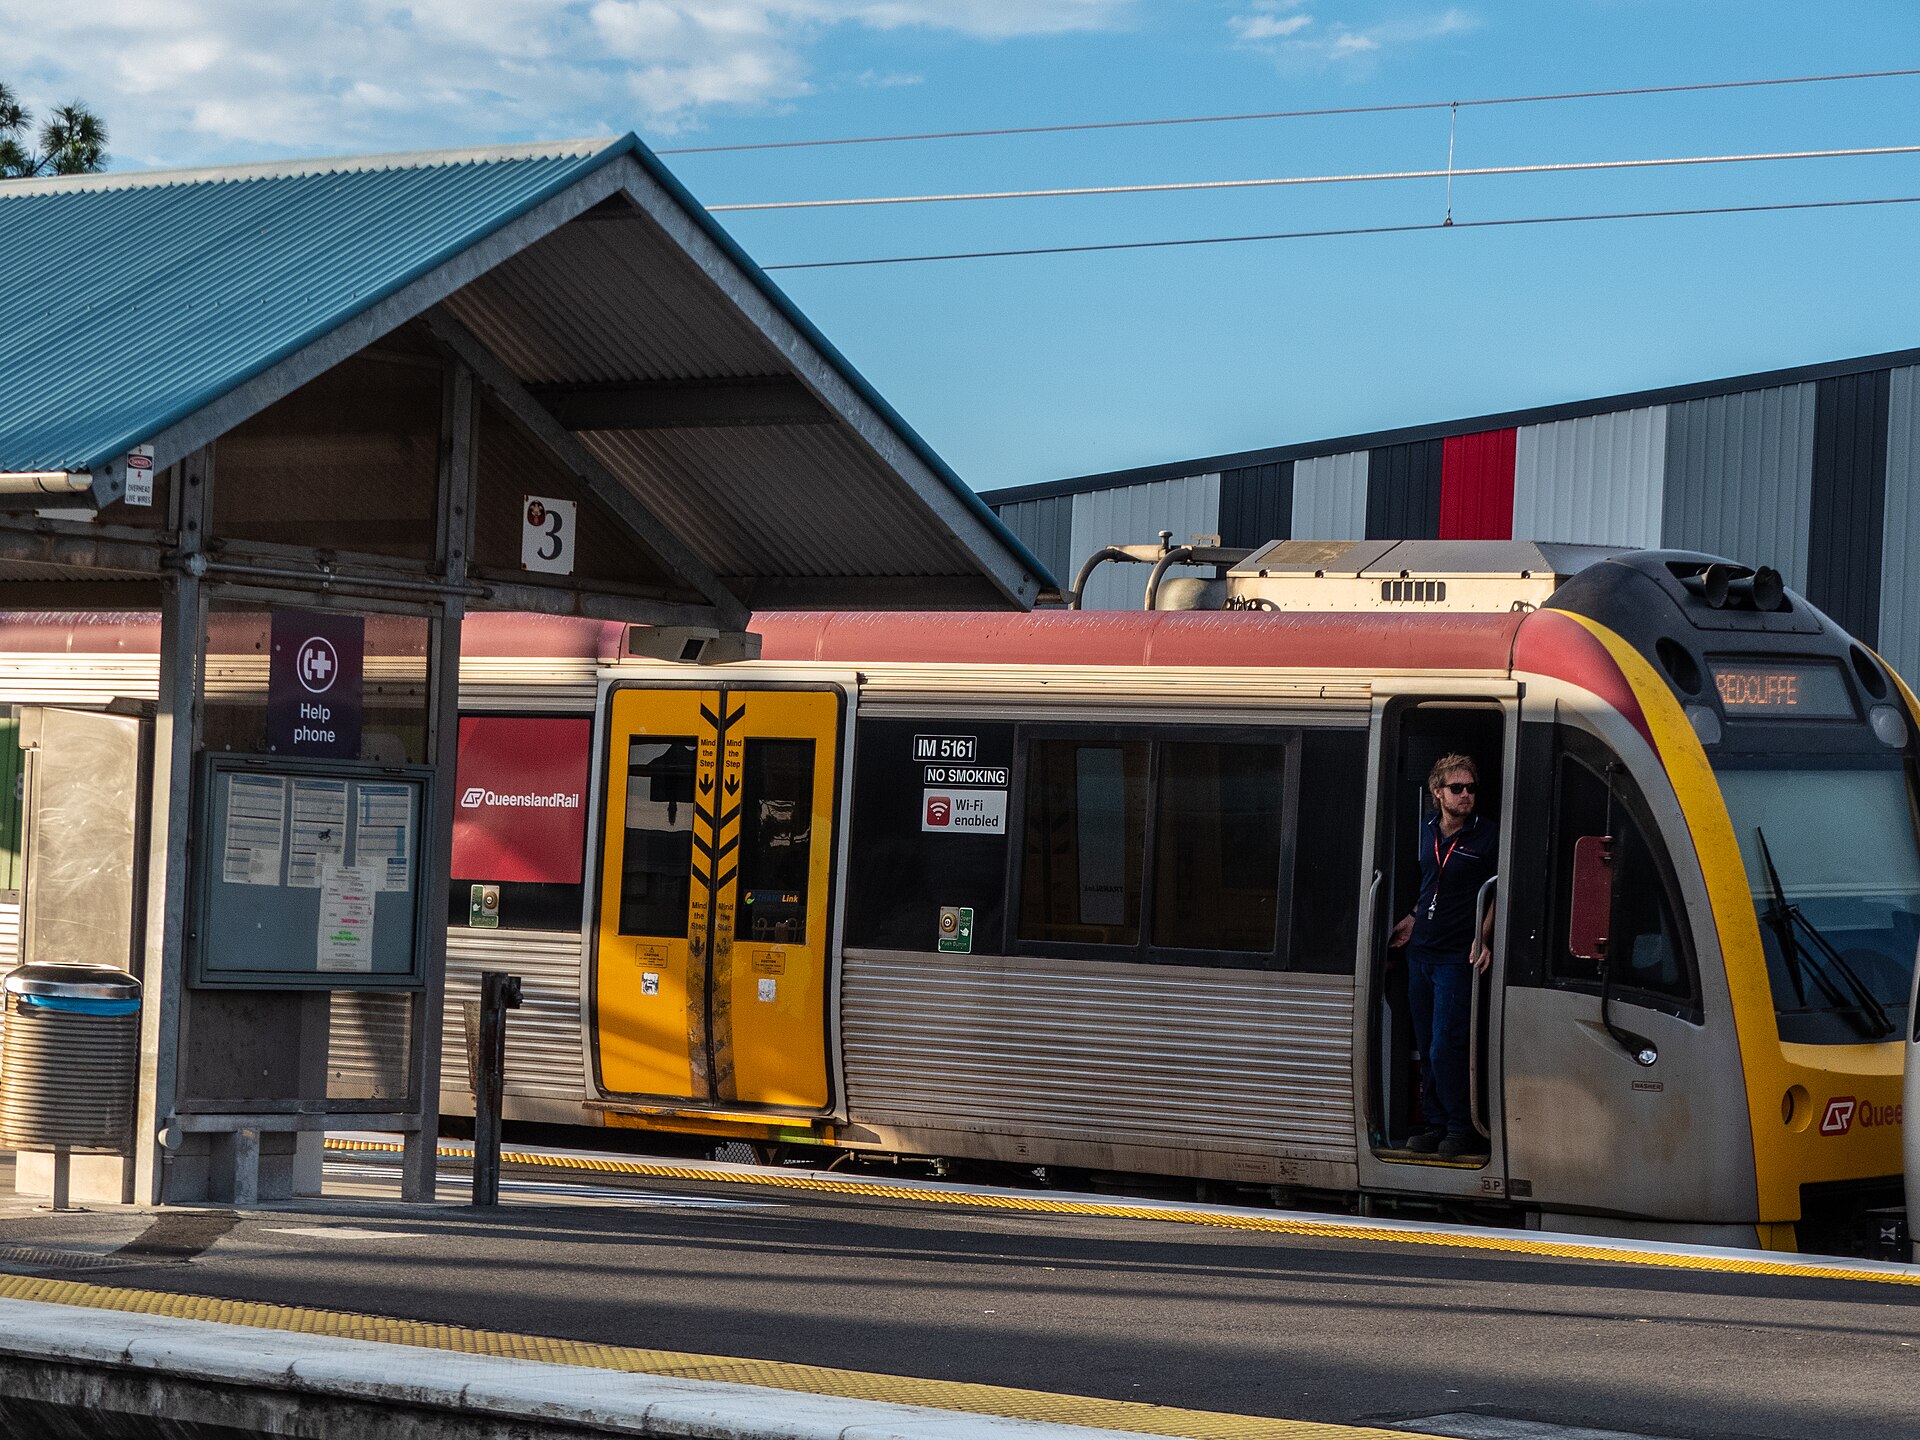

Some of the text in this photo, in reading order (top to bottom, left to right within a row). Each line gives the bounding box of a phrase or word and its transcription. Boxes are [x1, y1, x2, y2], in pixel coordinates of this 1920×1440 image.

[128, 484, 151, 493] OVERHEAD
[126, 494, 151, 504] LIVE WIRES
[536, 510, 563, 560] 3
[1715, 674, 1798, 705] REDCLIFFE
[300, 703, 331, 723] Help
[293, 725, 336, 744] phone
[700, 739, 716, 747] Mind
[726, 739, 742, 747] Mind
[918, 739, 973, 757] IM 5161
[699, 759, 715, 768] Step
[725, 760, 741, 769] Step
[927, 768, 1005, 783] NO SMOKING
[485, 791, 579, 808] QueenslandRail
[955, 799, 983, 811] Wi-Fi
[954, 814, 999, 827] enabled
[692, 901, 707, 909] Mind
[691, 922, 706, 931] Step
